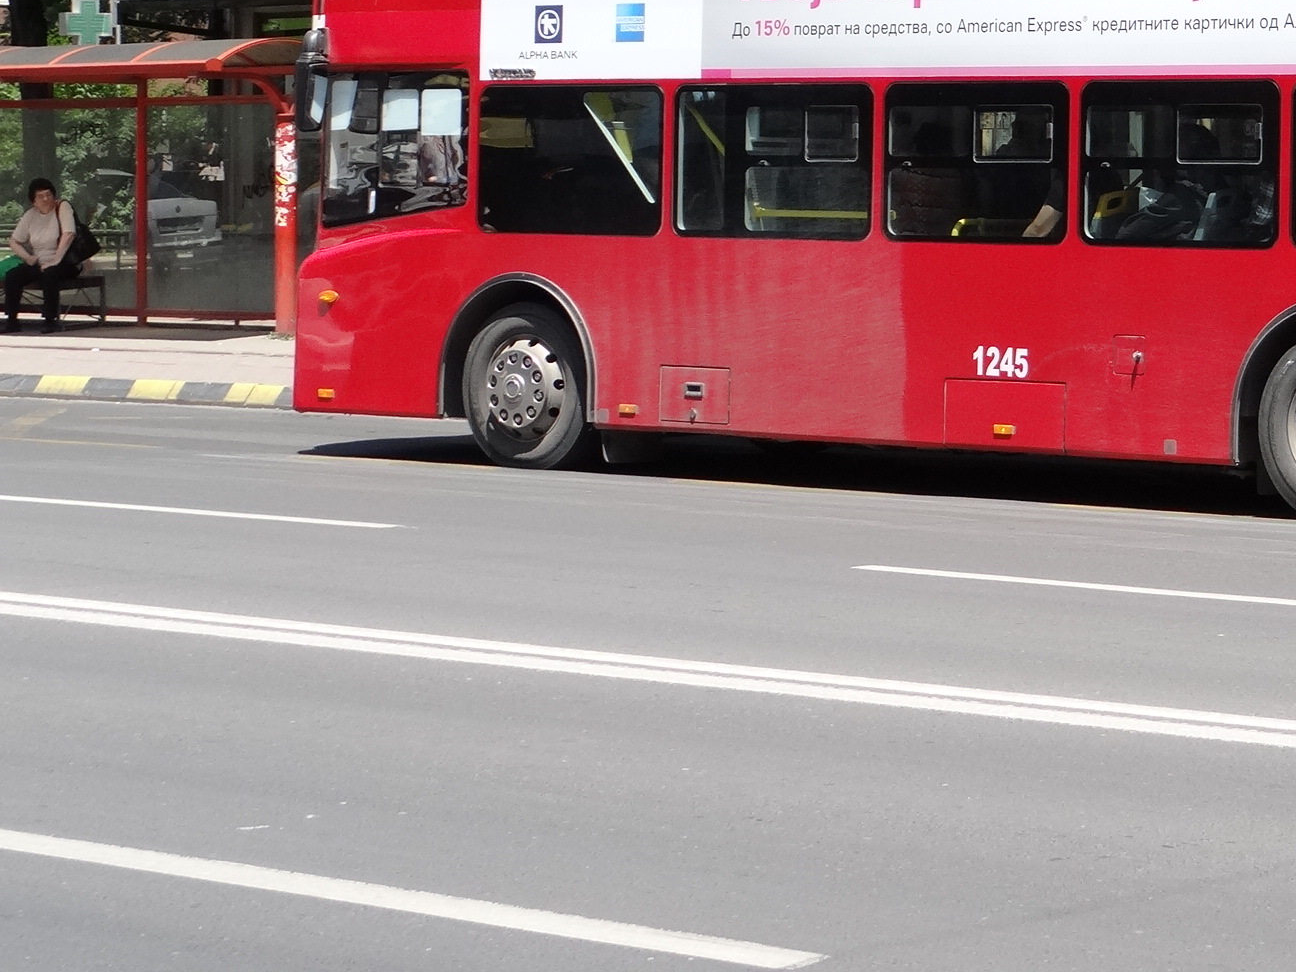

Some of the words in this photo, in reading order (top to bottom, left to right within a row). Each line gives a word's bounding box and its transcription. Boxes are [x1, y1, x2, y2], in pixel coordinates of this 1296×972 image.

[731, 22, 751, 39] До
[754, 19, 791, 36] 15%
[793, 22, 841, 39] поврат
[845, 25, 860, 36] на
[864, 23, 932, 38] средства,
[936, 23, 953, 34] со
[956, 18, 1022, 34] American
[1092, 18, 1179, 35] кредитните
[1184, 17, 1255, 33] картички
[1260, 16, 1279, 31] од
[518, 51, 549, 60] ALPHA
[550, 50, 578, 59] BANK
[972, 345, 1029, 378] 1245
